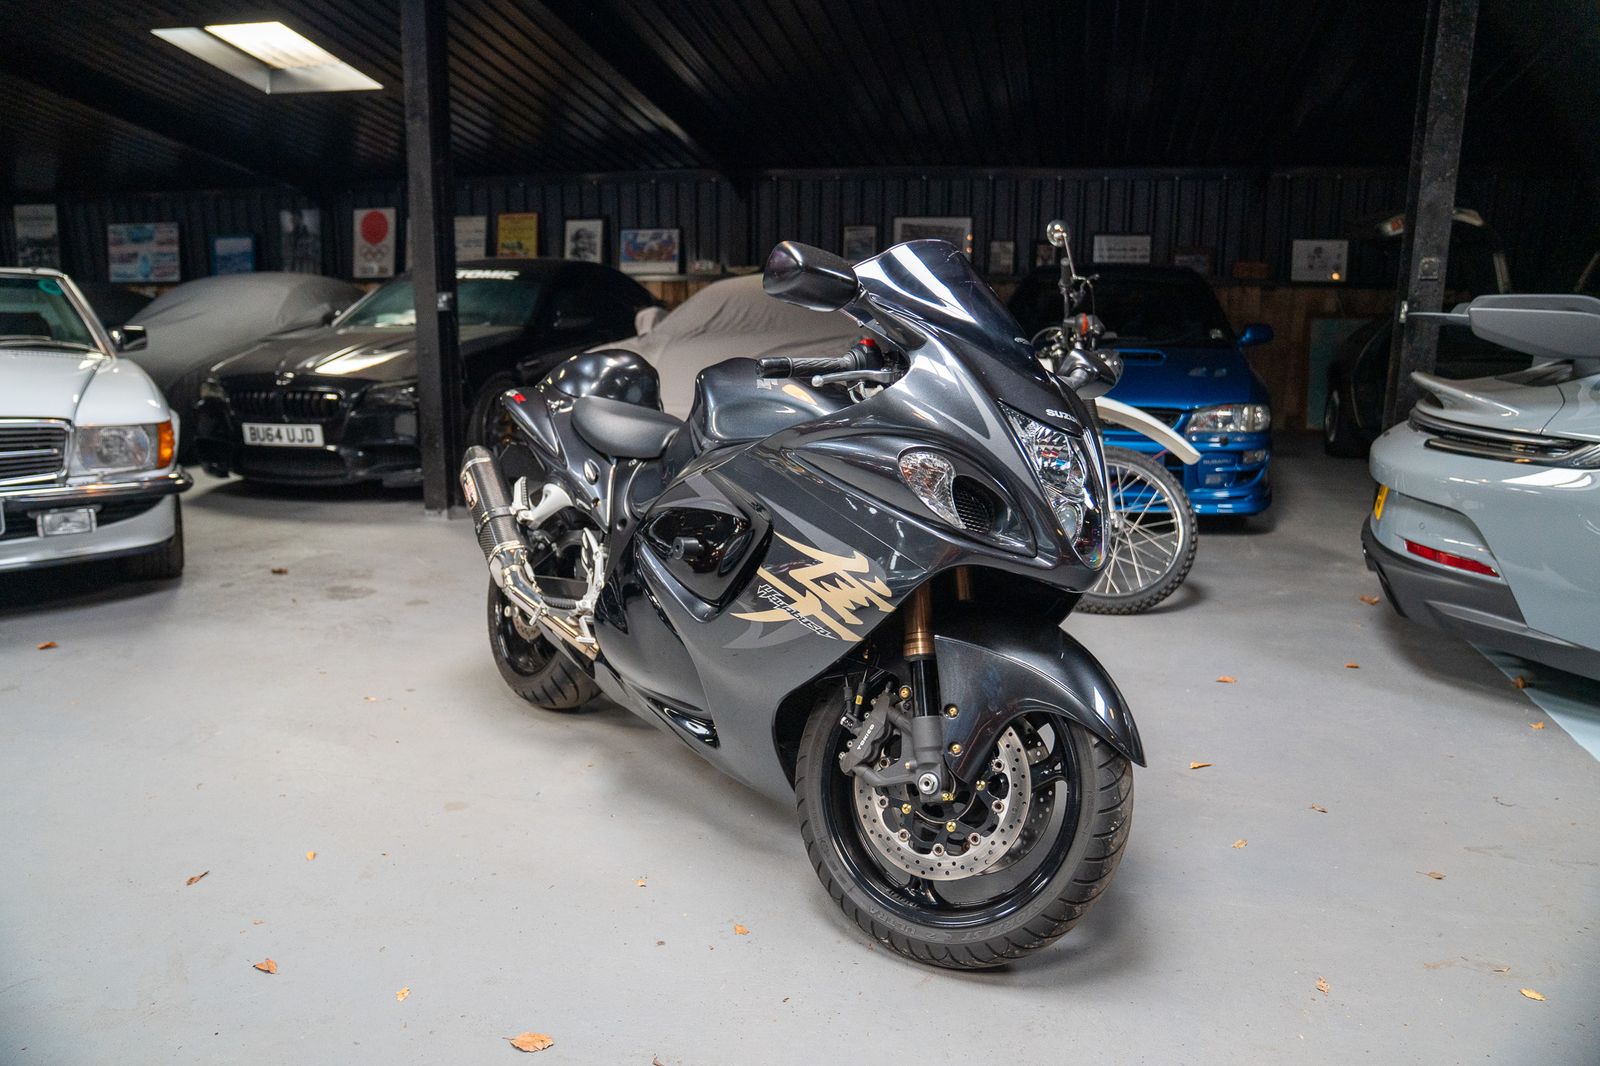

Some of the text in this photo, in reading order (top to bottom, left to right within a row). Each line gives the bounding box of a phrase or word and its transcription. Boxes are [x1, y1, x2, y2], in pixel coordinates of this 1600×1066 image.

[248, 426, 315, 444] BU64 UJD
[856, 723, 875, 750] TOKICO
